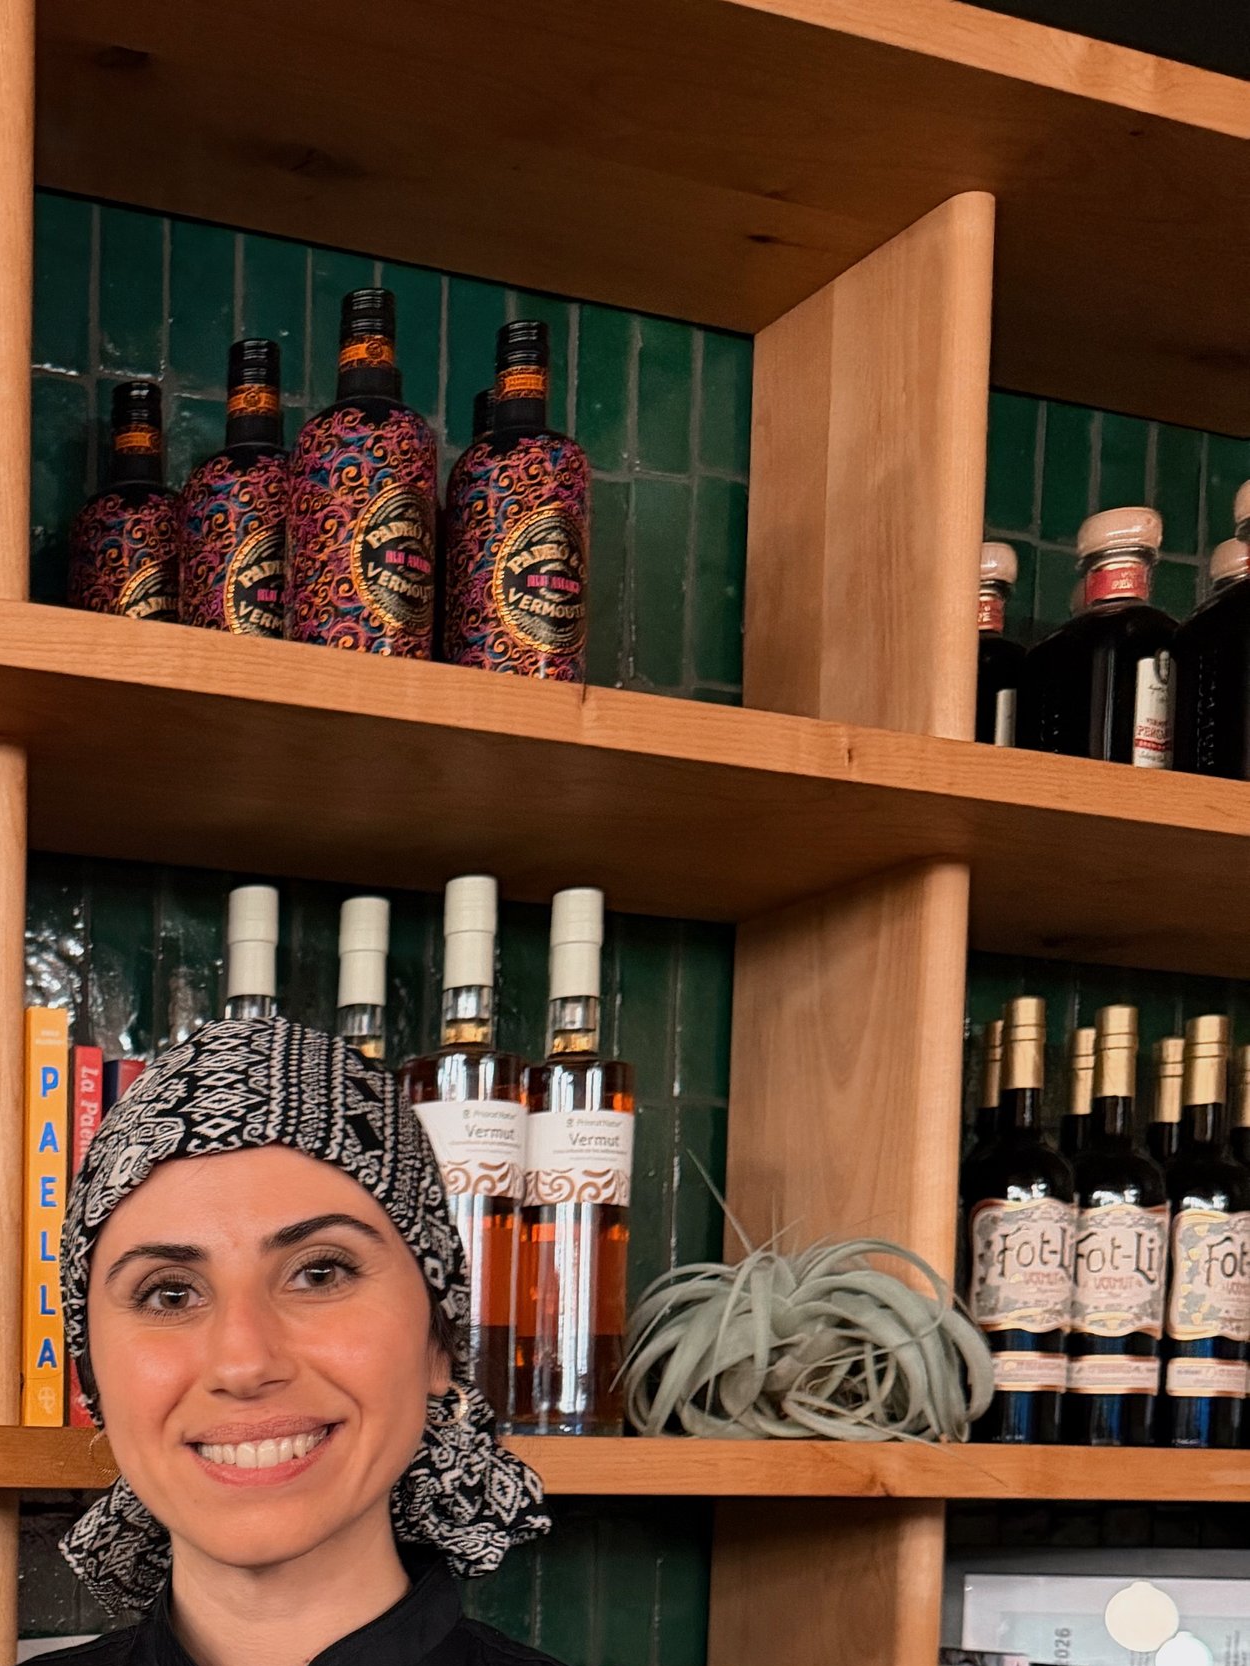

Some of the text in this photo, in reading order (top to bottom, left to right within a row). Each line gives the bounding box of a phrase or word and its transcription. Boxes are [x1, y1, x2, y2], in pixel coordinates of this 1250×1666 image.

[80, 1066, 99, 1093] La
[466, 1124, 515, 1141] Vermut
[569, 1133, 620, 1146] Vermut
[37, 1066, 59, 1369] PAELLA
[1071, 1230, 1156, 1285] Fot-Li
